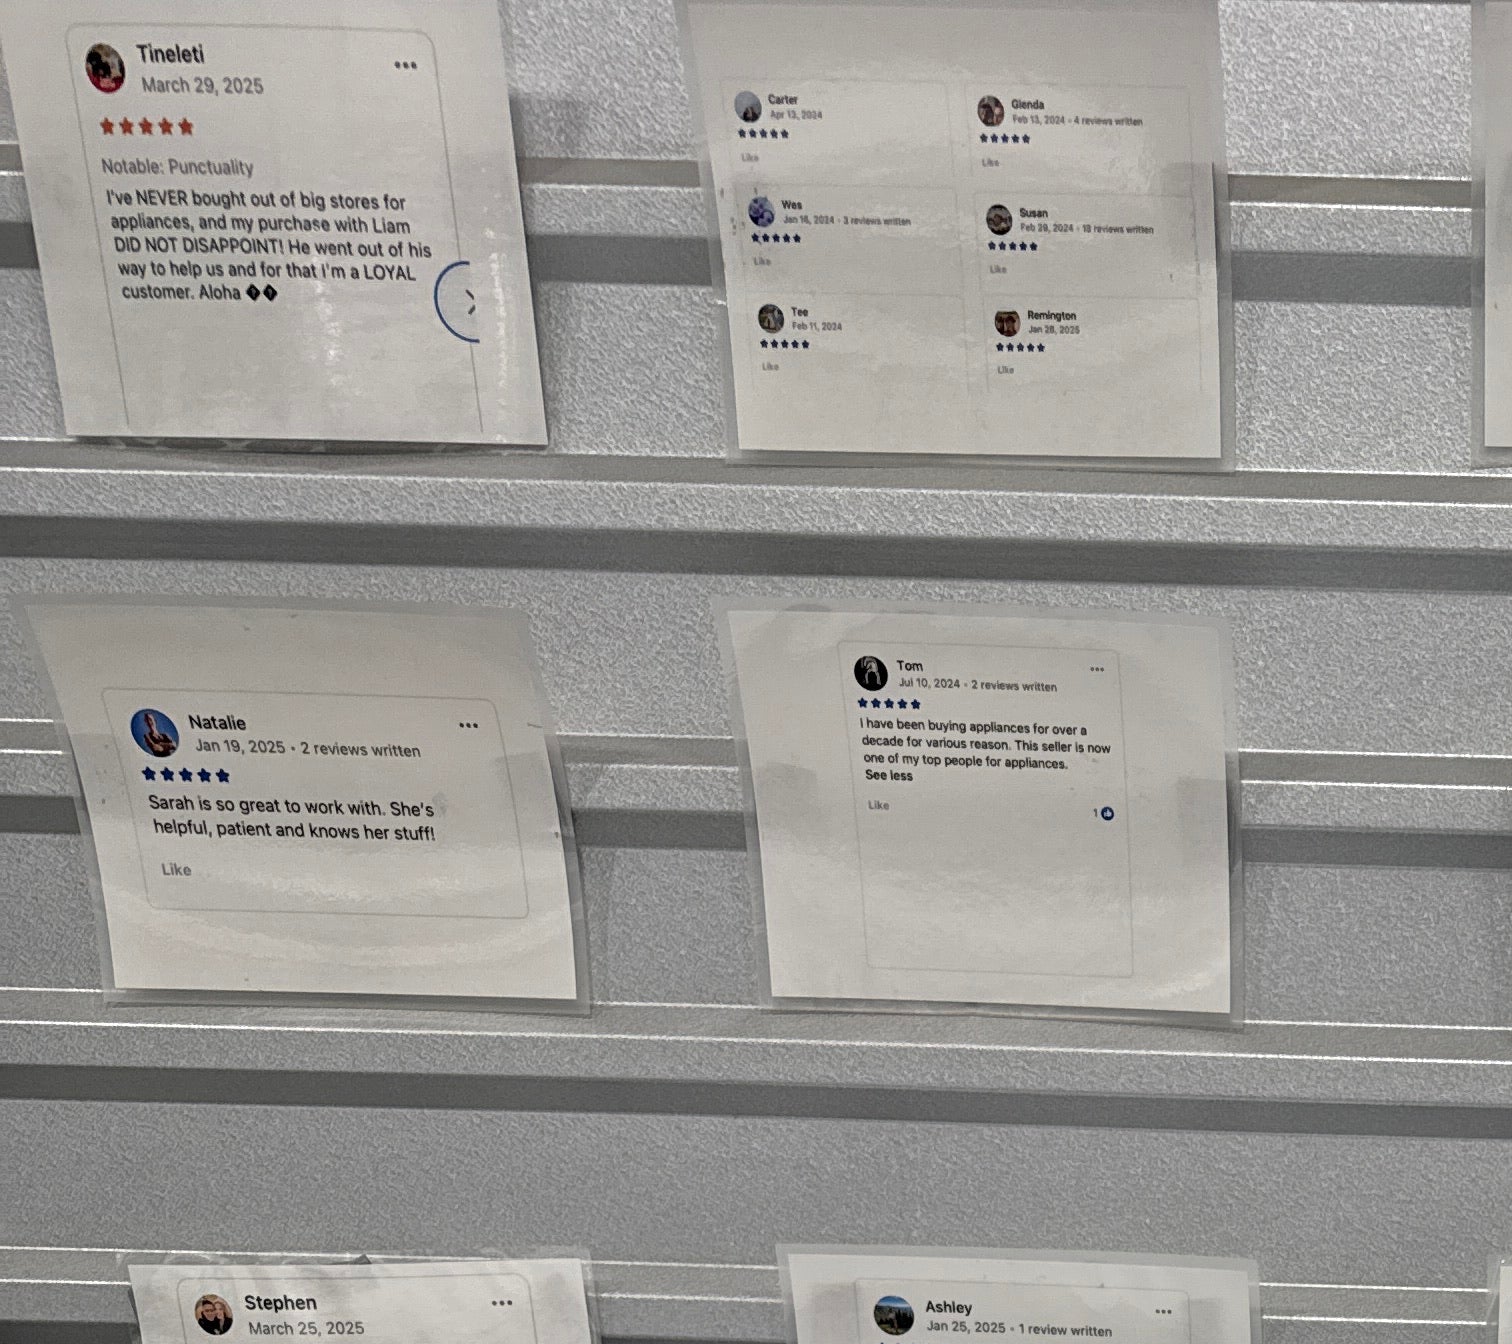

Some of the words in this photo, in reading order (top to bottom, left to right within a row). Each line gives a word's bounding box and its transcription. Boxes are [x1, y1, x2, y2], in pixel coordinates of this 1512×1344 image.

[135, 43, 205, 64] Tineleti
[141, 76, 191, 94] March
[193, 76, 219, 97] 29,
[222, 76, 264, 95] 2025
[101, 157, 165, 175] Notable:
[167, 158, 254, 179] Punctuality
[106, 189, 133, 206] I've
[135, 189, 189, 207] NEVER
[191, 189, 247, 211] bought
[250, 192, 277, 208] out
[279, 190, 296, 208] of
[299, 191, 326, 212] big
[329, 193, 380, 211] stores
[383, 193, 406, 211] for
[122, 284, 195, 300] customer.
[199, 283, 242, 301] Aloha
[896, 659, 924, 672] Tom
[188, 714, 247, 731] Natalie
[865, 768, 888, 781] See
[889, 769, 914, 782] less
[152, 818, 212, 838] helpful,
[216, 820, 273, 839] patient
[275, 822, 305, 838] and
[308, 822, 360, 840] knows
[363, 824, 390, 840] her
[394, 825, 436, 841] stuff!
[244, 1294, 318, 1314] Stephen
[925, 1300, 973, 1317] Ashley
[248, 1321, 294, 1336] March
[297, 1321, 322, 1337] 25,
[325, 1320, 365, 1335] 2025
